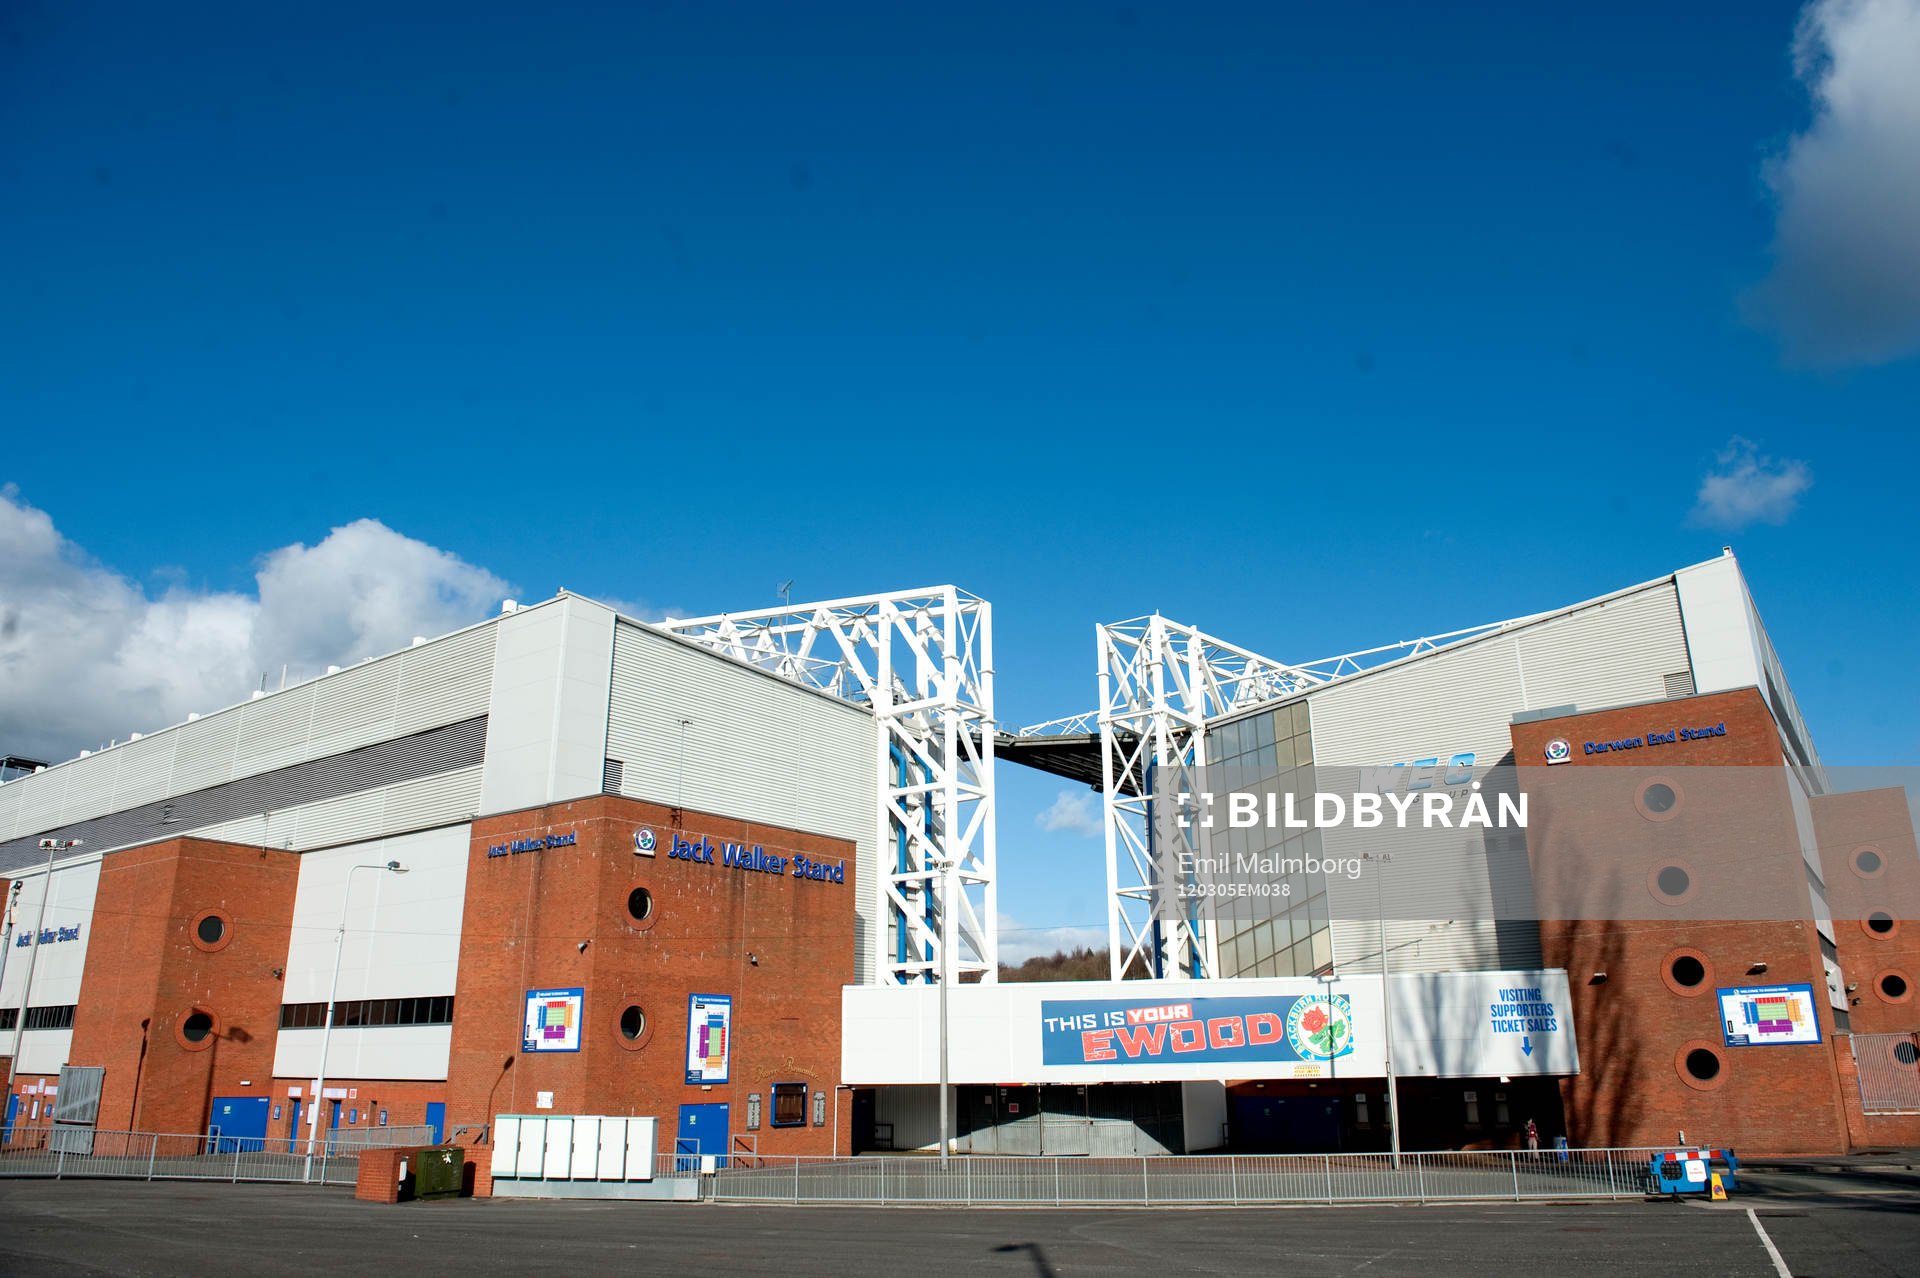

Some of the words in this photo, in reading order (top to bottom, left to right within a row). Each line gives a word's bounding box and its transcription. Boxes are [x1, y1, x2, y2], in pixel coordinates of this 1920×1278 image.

[1584, 736, 1643, 755] Darwen
[1647, 729, 1677, 746] End
[1680, 721, 1726, 741] Stand
[1412, 789, 1469, 804] GUP
[488, 842, 508, 858] Jack
[510, 837, 545, 854] Walker
[546, 830, 577, 848] Stand
[668, 833, 714, 863] Jack
[721, 842, 789, 875] Walker
[792, 854, 845, 884] Stand
[1499, 988, 1542, 1002] VISITING
[1044, 1013, 1097, 1032] THIS
[1105, 1010, 1125, 1027] IS
[1128, 1005, 1190, 1023] YOUR
[1490, 1003, 1554, 1017] SUPPORTERS
[1081, 1012, 1283, 1061] EWOOD
[1491, 1019, 1526, 1032] TICKET
[1527, 1018, 1558, 1032] SALES
